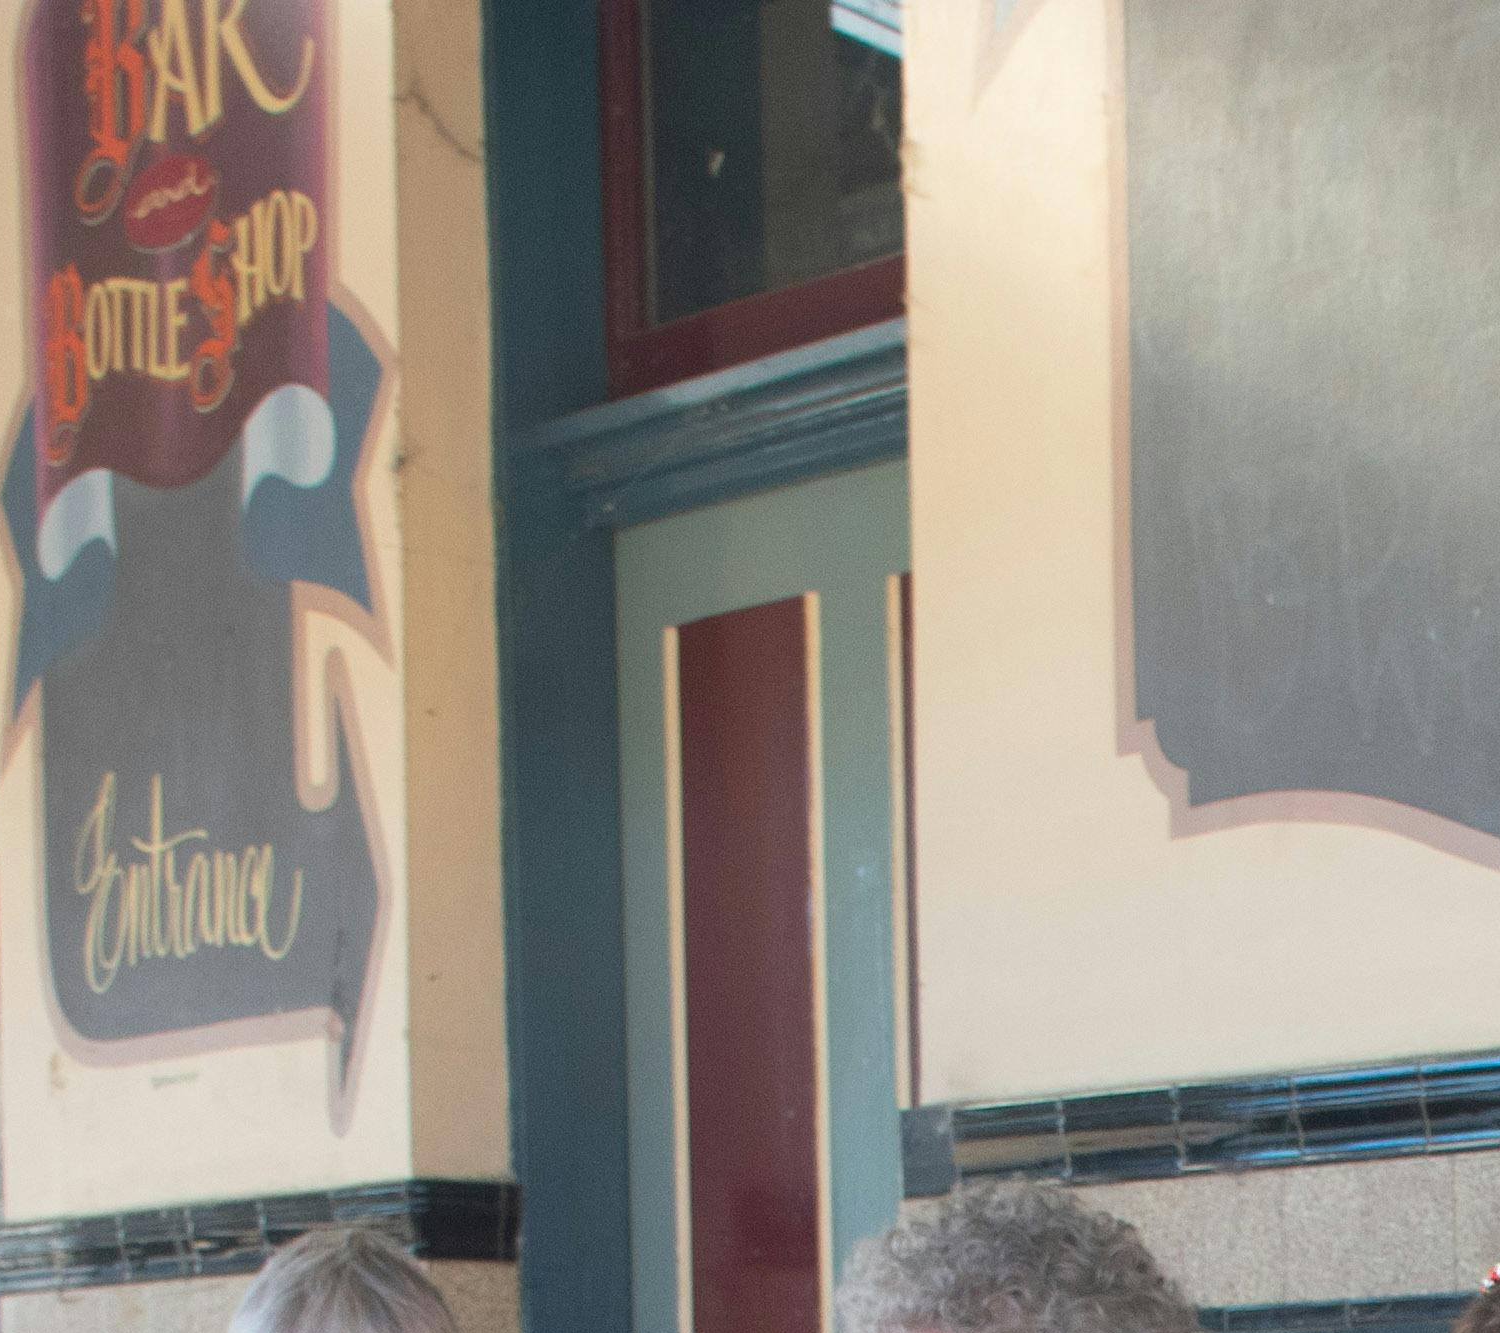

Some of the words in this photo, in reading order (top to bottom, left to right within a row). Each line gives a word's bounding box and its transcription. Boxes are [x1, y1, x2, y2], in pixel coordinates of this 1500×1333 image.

[45, 262, 192, 466] BOTTLE
[190, 189, 320, 412] SHOP
[73, 770, 304, 994] Entrance
